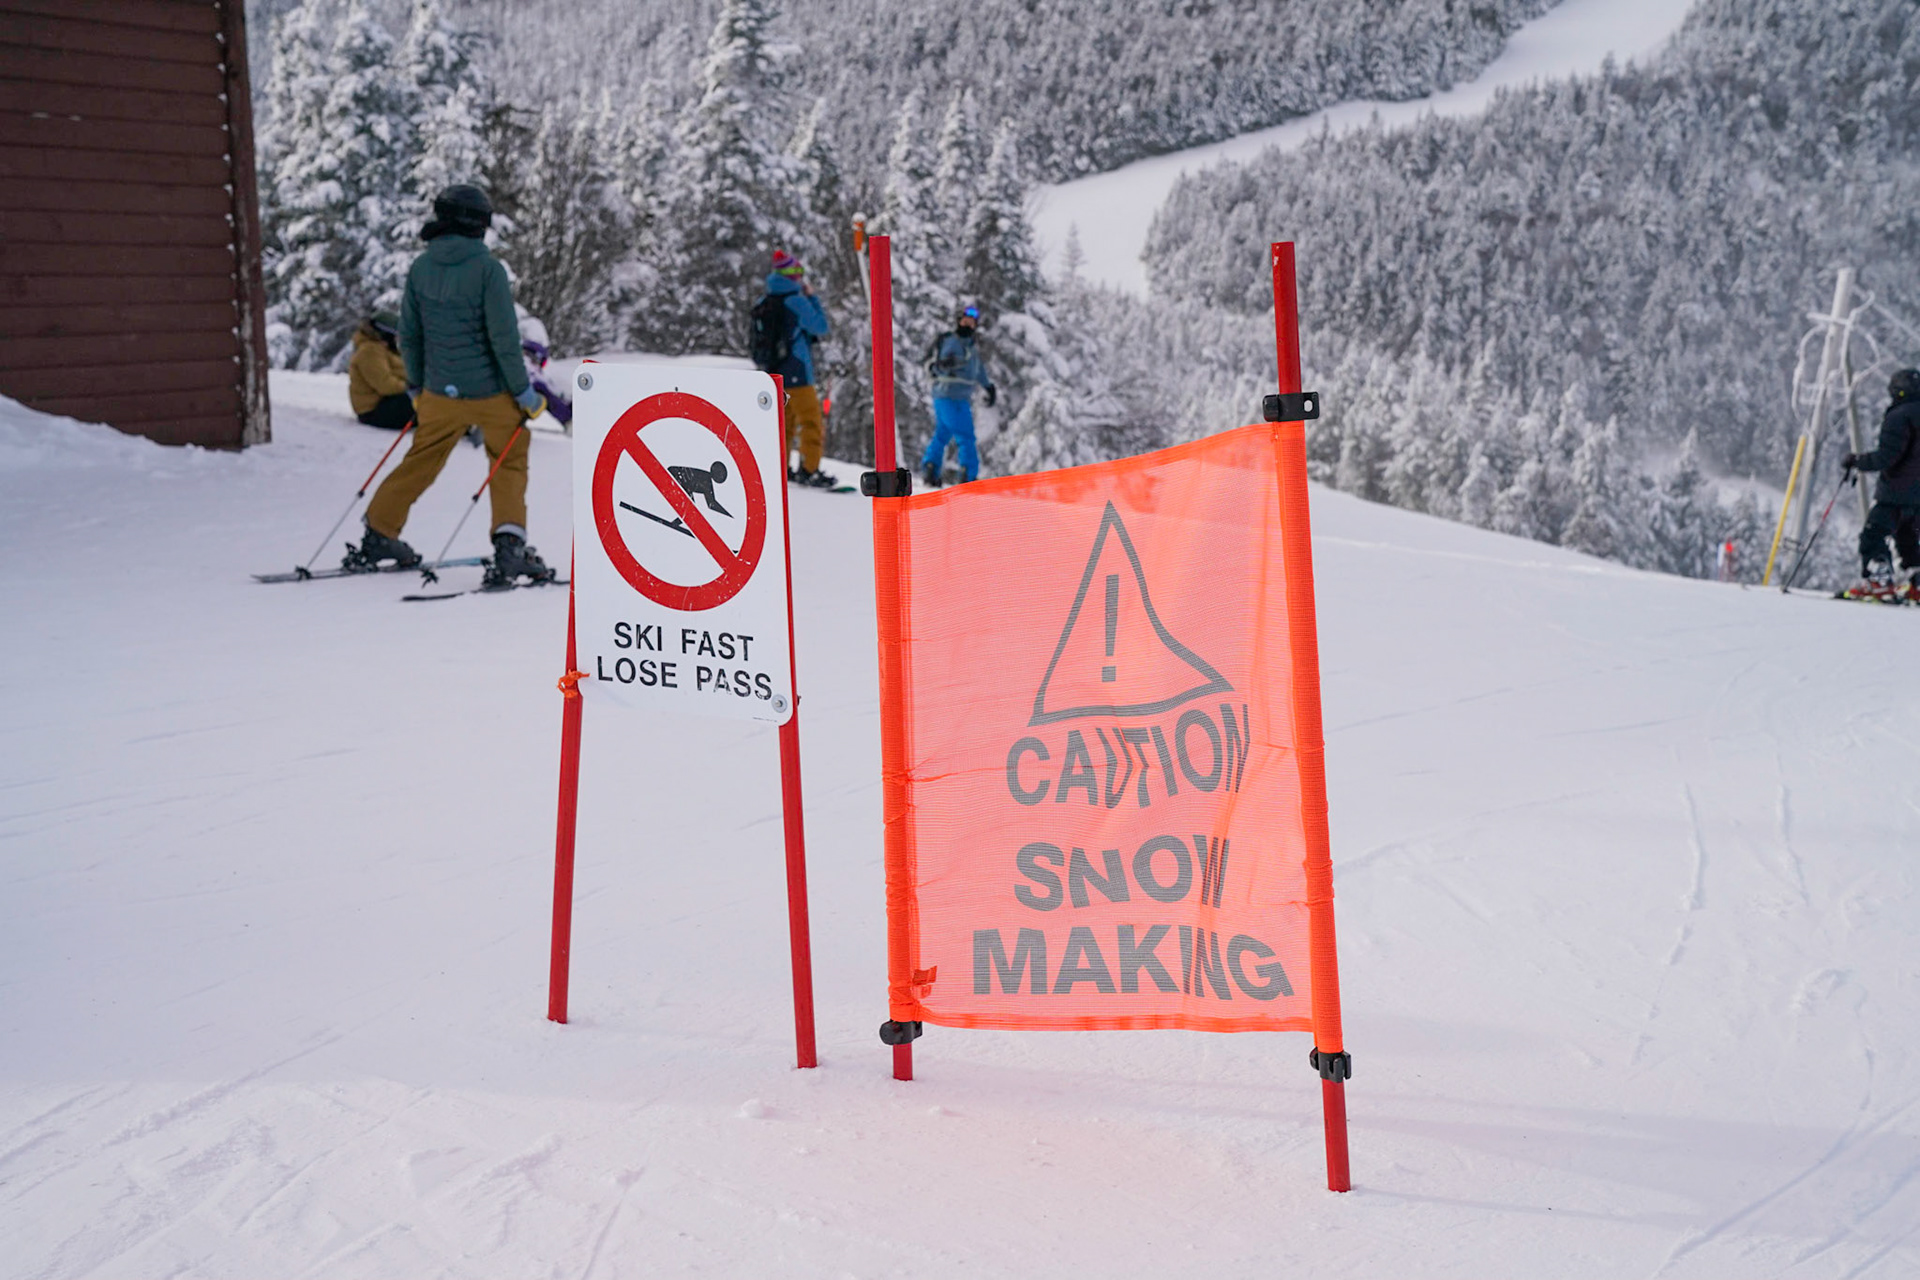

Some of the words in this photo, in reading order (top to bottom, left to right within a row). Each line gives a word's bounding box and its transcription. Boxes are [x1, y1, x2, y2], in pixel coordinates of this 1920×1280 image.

[597, 655, 678, 689] LOSE
[696, 665, 773, 701] PASS
[614, 622, 663, 651] SKI
[681, 628, 754, 662] FAST
[1006, 703, 1250, 809] CAUTION
[1014, 834, 1230, 912] SNOW
[973, 924, 1295, 1001] MAKING
